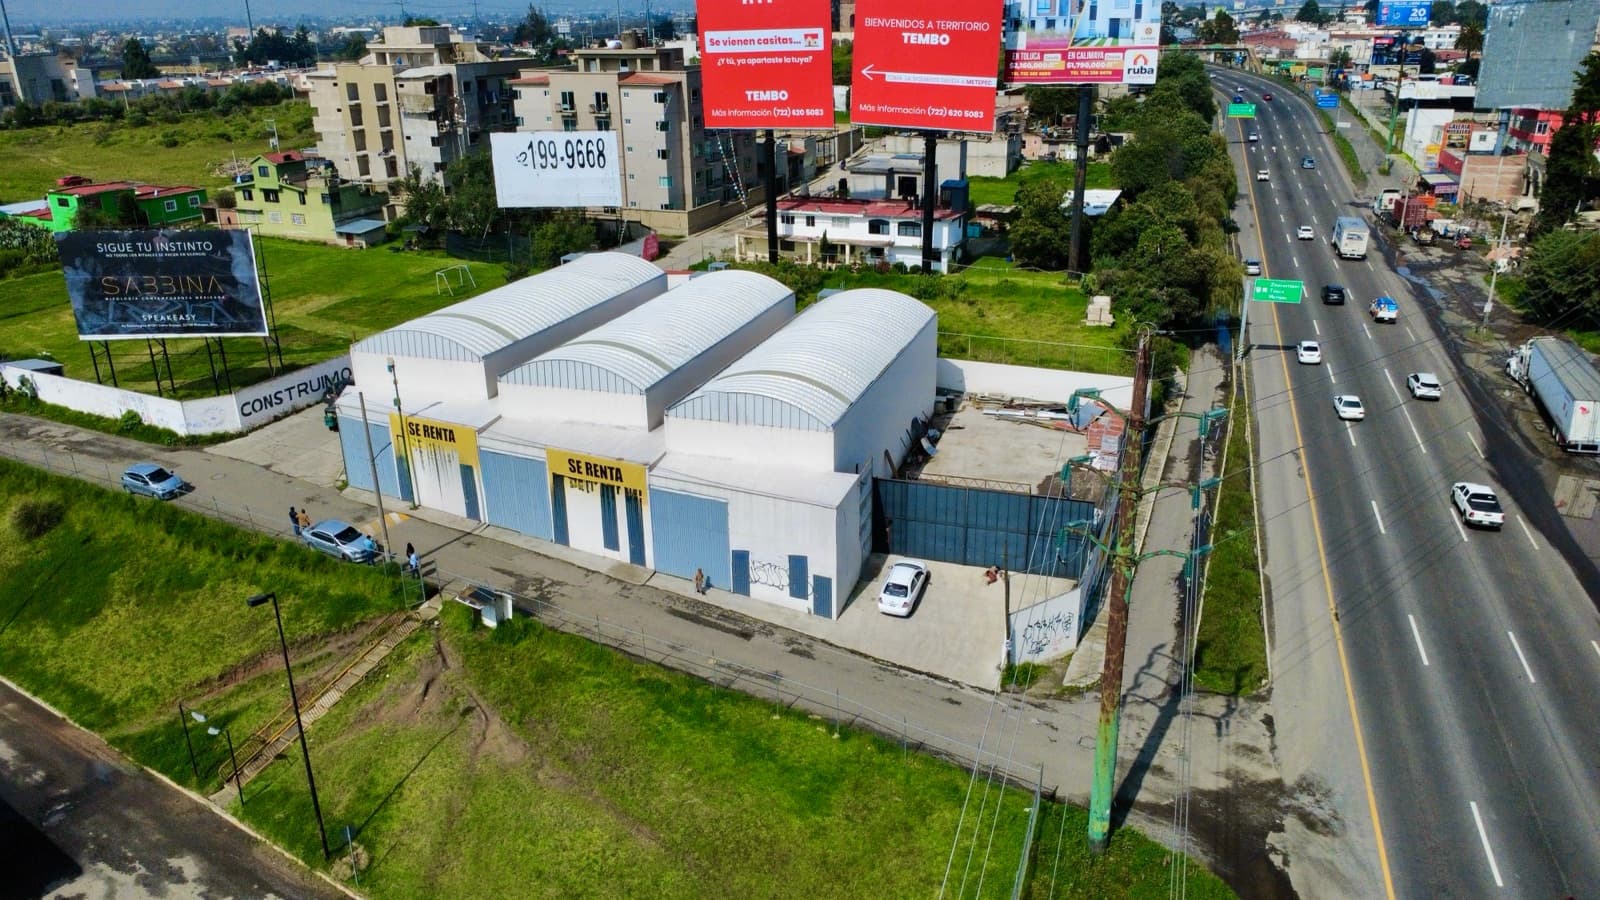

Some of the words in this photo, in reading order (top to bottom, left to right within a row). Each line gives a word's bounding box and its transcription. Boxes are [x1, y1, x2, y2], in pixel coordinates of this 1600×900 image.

[1410, 8, 1426, 17] 20
[865, 17, 925, 30] BIENVENIDOS
[926, 20, 934, 29] A
[936, 20, 990, 32] TERRITORIO
[709, 38, 721, 47] Se
[723, 36, 755, 46] vienen
[757, 35, 801, 46] casitas...
[902, 33, 950, 46] TEMBO
[737, 58, 746, 66] ya
[747, 57, 783, 65] apartaste
[784, 56, 791, 64] la
[791, 55, 813, 64] tuya?
[1127, 65, 1154, 75] ruba
[745, 90, 788, 102] TEMBO
[711, 108, 727, 116] Más
[728, 107, 772, 117] información
[773, 108, 791, 118] (722)
[792, 109, 805, 117] 620
[806, 109, 824, 117] 5083
[859, 104, 876, 112] Más
[877, 104, 926, 115] información
[927, 106, 948, 117] (722)
[948, 108, 962, 118] 620
[963, 109, 984, 119] 5083
[96, 242, 133, 253] SIGUE
[136, 242, 152, 252] TU
[156, 241, 212, 252] INSTINTO
[101, 274, 225, 295] SABBINA
[141, 314, 196, 322] SPEAKEASY
[407, 422, 421, 437] SE
[423, 424, 456, 443] RENTA
[567, 458, 583, 474] SE
[585, 463, 624, 483] RENTA
